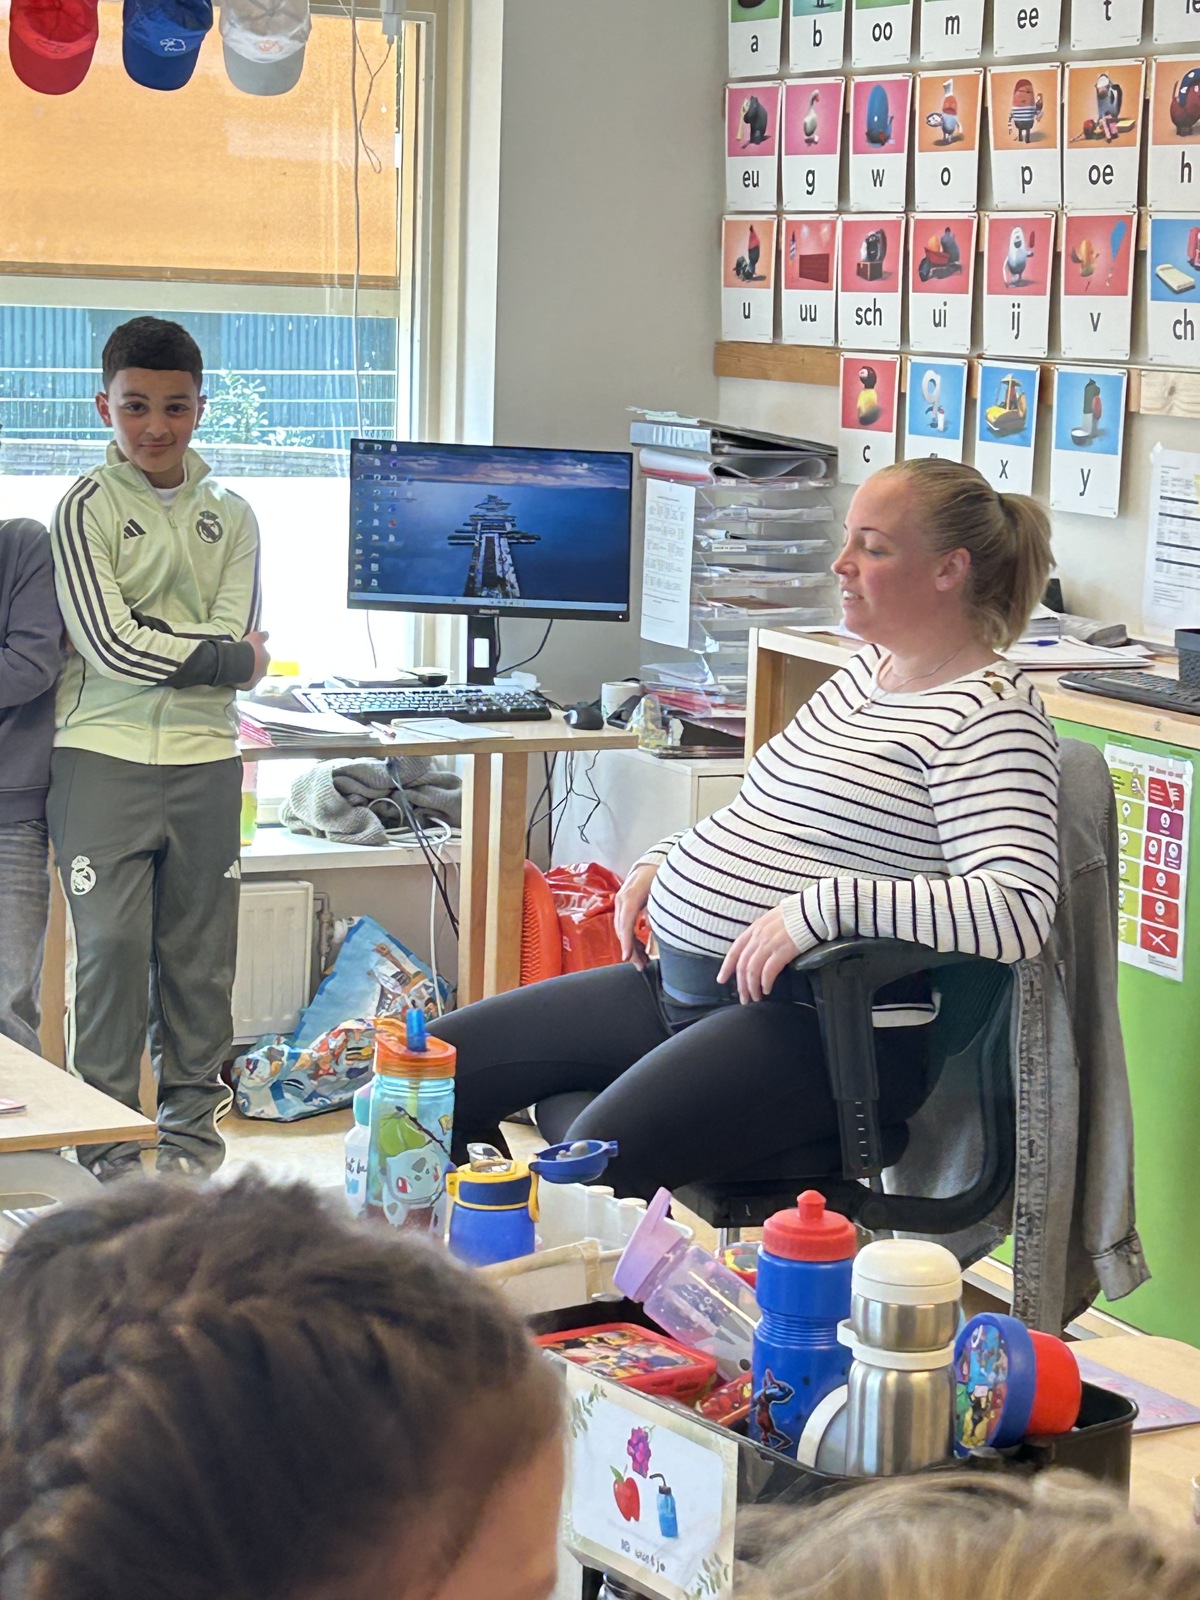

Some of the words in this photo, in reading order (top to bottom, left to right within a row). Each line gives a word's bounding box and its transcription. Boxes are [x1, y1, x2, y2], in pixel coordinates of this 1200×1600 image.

[1016, 7, 1040, 30] ee
[1102, 0, 1113, 22] t
[812, 18, 823, 48] b
[871, 21, 893, 43] oo
[944, 14, 961, 36] m
[750, 34, 759, 54] a
[871, 168, 885, 188] w
[940, 166, 952, 187] o
[1088, 164, 1114, 186] oe
[1180, 150, 1192, 184] h
[742, 170, 760, 189] eu
[805, 169, 816, 196] g
[1020, 165, 1033, 195] p
[742, 301, 751, 320] u
[799, 303, 817, 323] uu
[855, 297, 883, 327] sch
[932, 300, 948, 328] ui
[1011, 302, 1021, 340] ij
[1089, 312, 1102, 333] v
[1172, 308, 1195, 341] ch
[862, 444, 871, 464] c
[998, 459, 1009, 480] x
[1078, 467, 1092, 497] y
